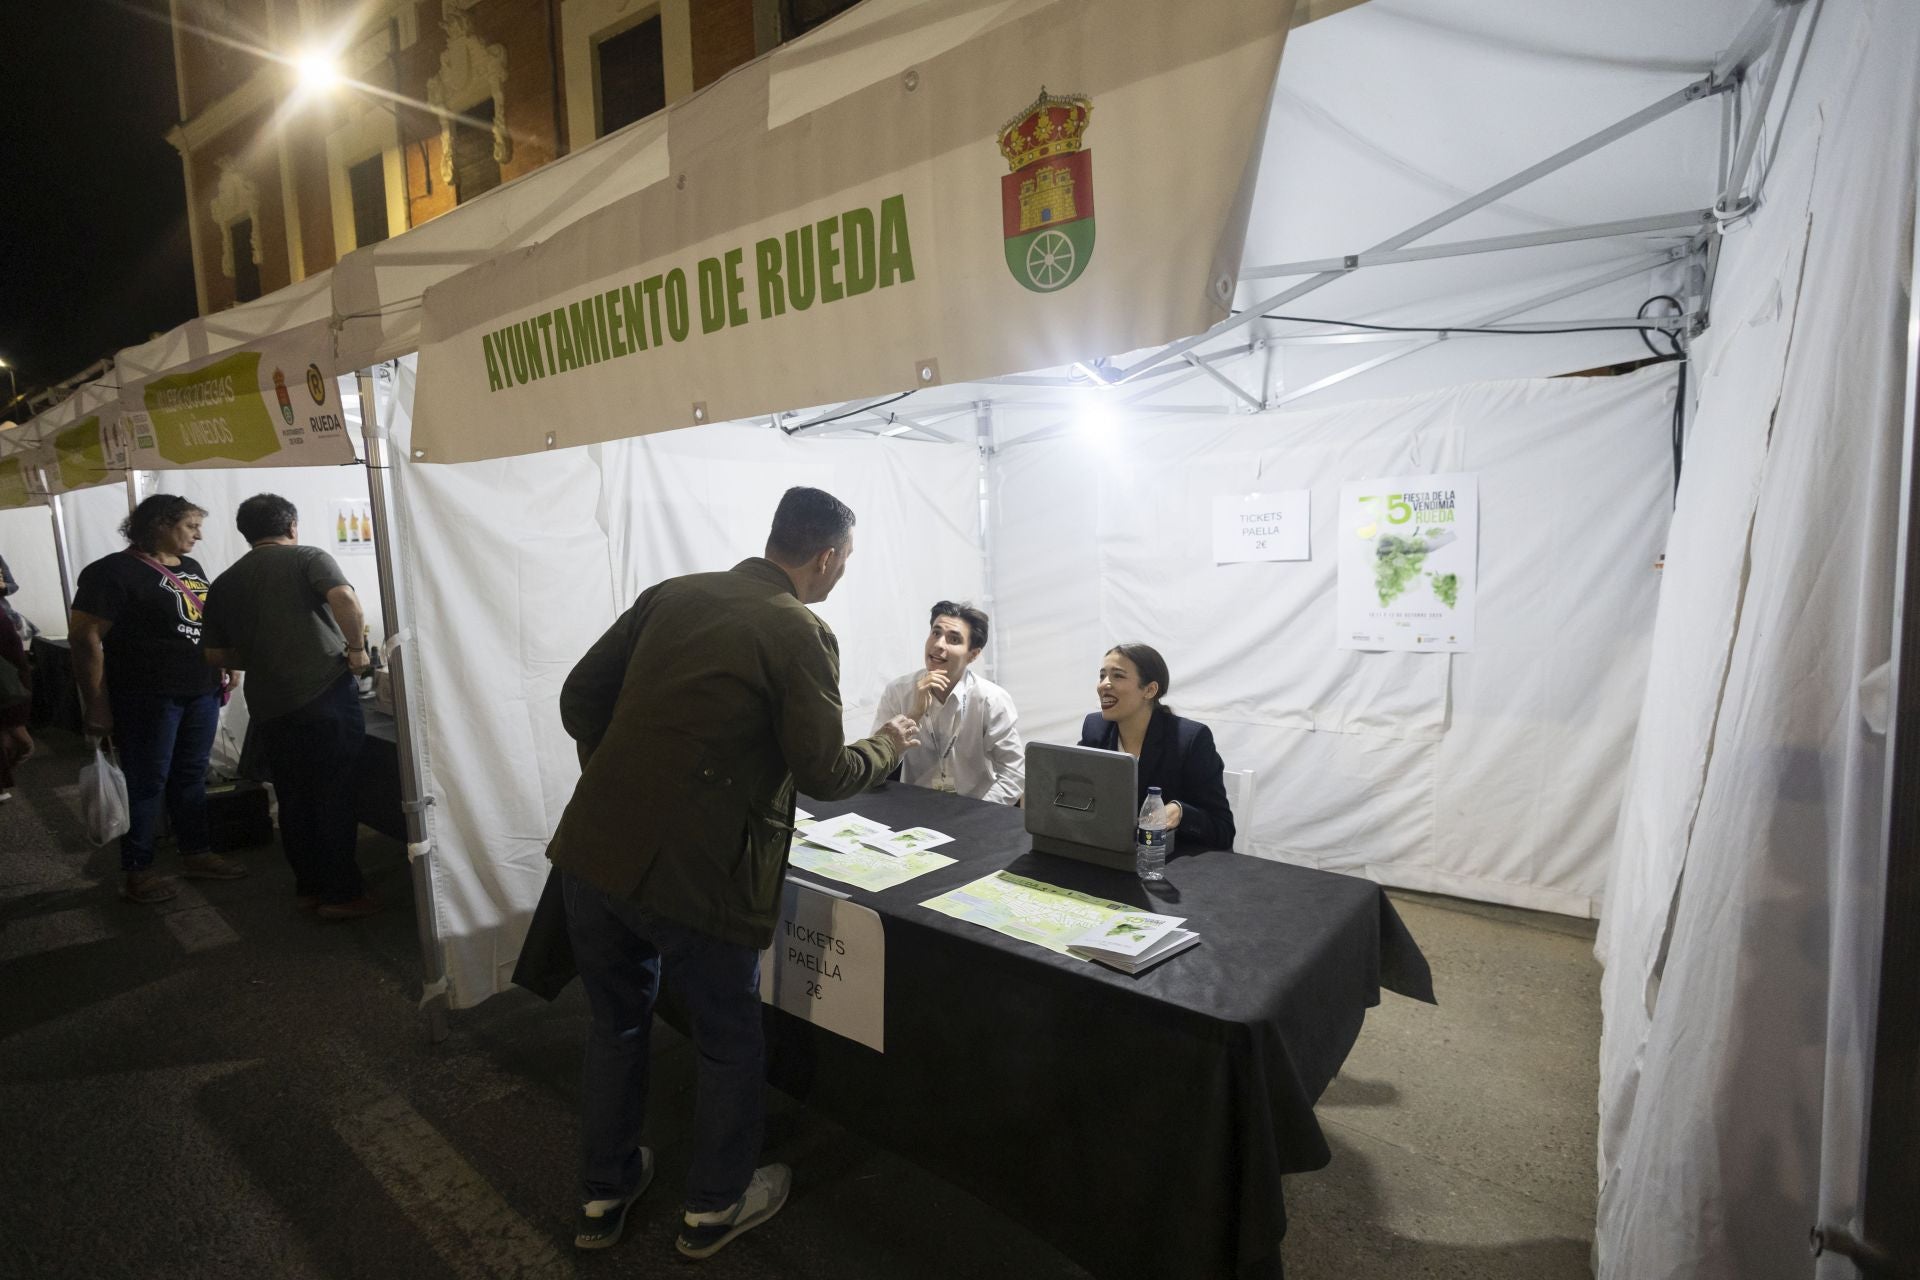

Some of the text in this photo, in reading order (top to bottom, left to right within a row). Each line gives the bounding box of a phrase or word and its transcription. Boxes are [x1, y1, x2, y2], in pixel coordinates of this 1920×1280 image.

[482, 194, 915, 392] AYUNTAMIENTO DE RUEDA
[310, 414, 341, 433] RUEDA
[1403, 492, 1430, 502] FIESTA
[1432, 491, 1443, 501] DE
[1445, 490, 1456, 500] LA
[1413, 500, 1455, 511] VENDIMIA
[1239, 511, 1282, 523] TICKETS
[1415, 509, 1455, 524] RUEDA
[1242, 526, 1279, 536] PAELLA
[1256, 540, 1267, 549] 2€
[177, 624, 201, 636] GRA
[784, 919, 845, 955] TICKETS
[788, 947, 842, 981] PAELLA
[805, 980, 823, 1000] 2€
